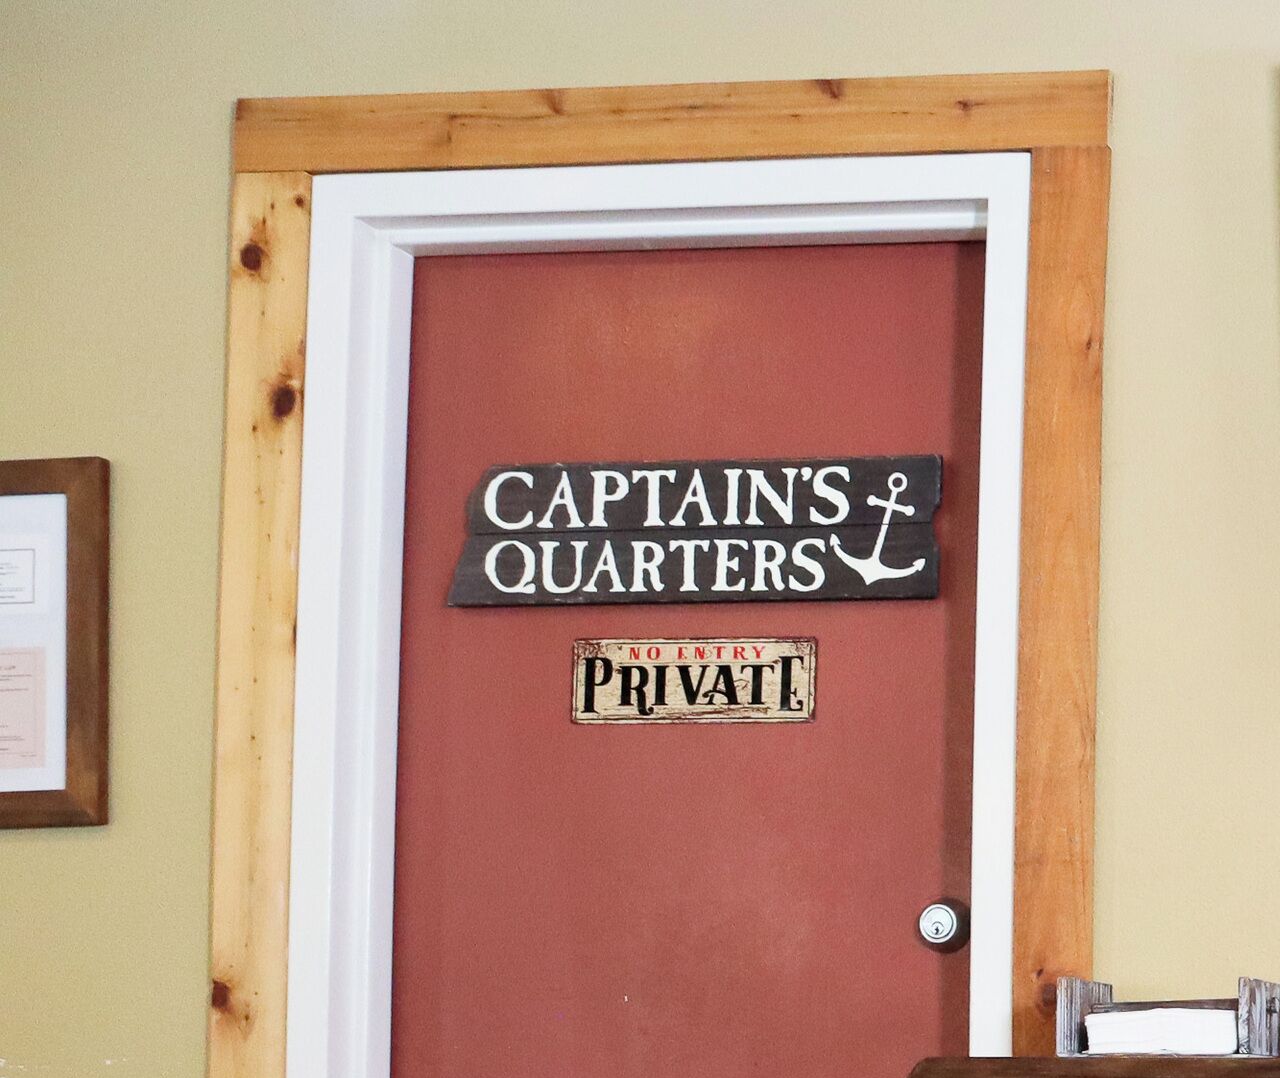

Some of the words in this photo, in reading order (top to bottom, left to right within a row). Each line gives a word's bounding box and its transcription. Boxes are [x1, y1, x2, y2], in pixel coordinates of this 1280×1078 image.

[483, 466, 851, 530] CAPTAIN'S
[483, 536, 827, 594] QUARTERS
[628, 647, 661, 661] NO
[677, 645, 766, 661] ENTRY
[580, 655, 806, 716] PRIVATE
